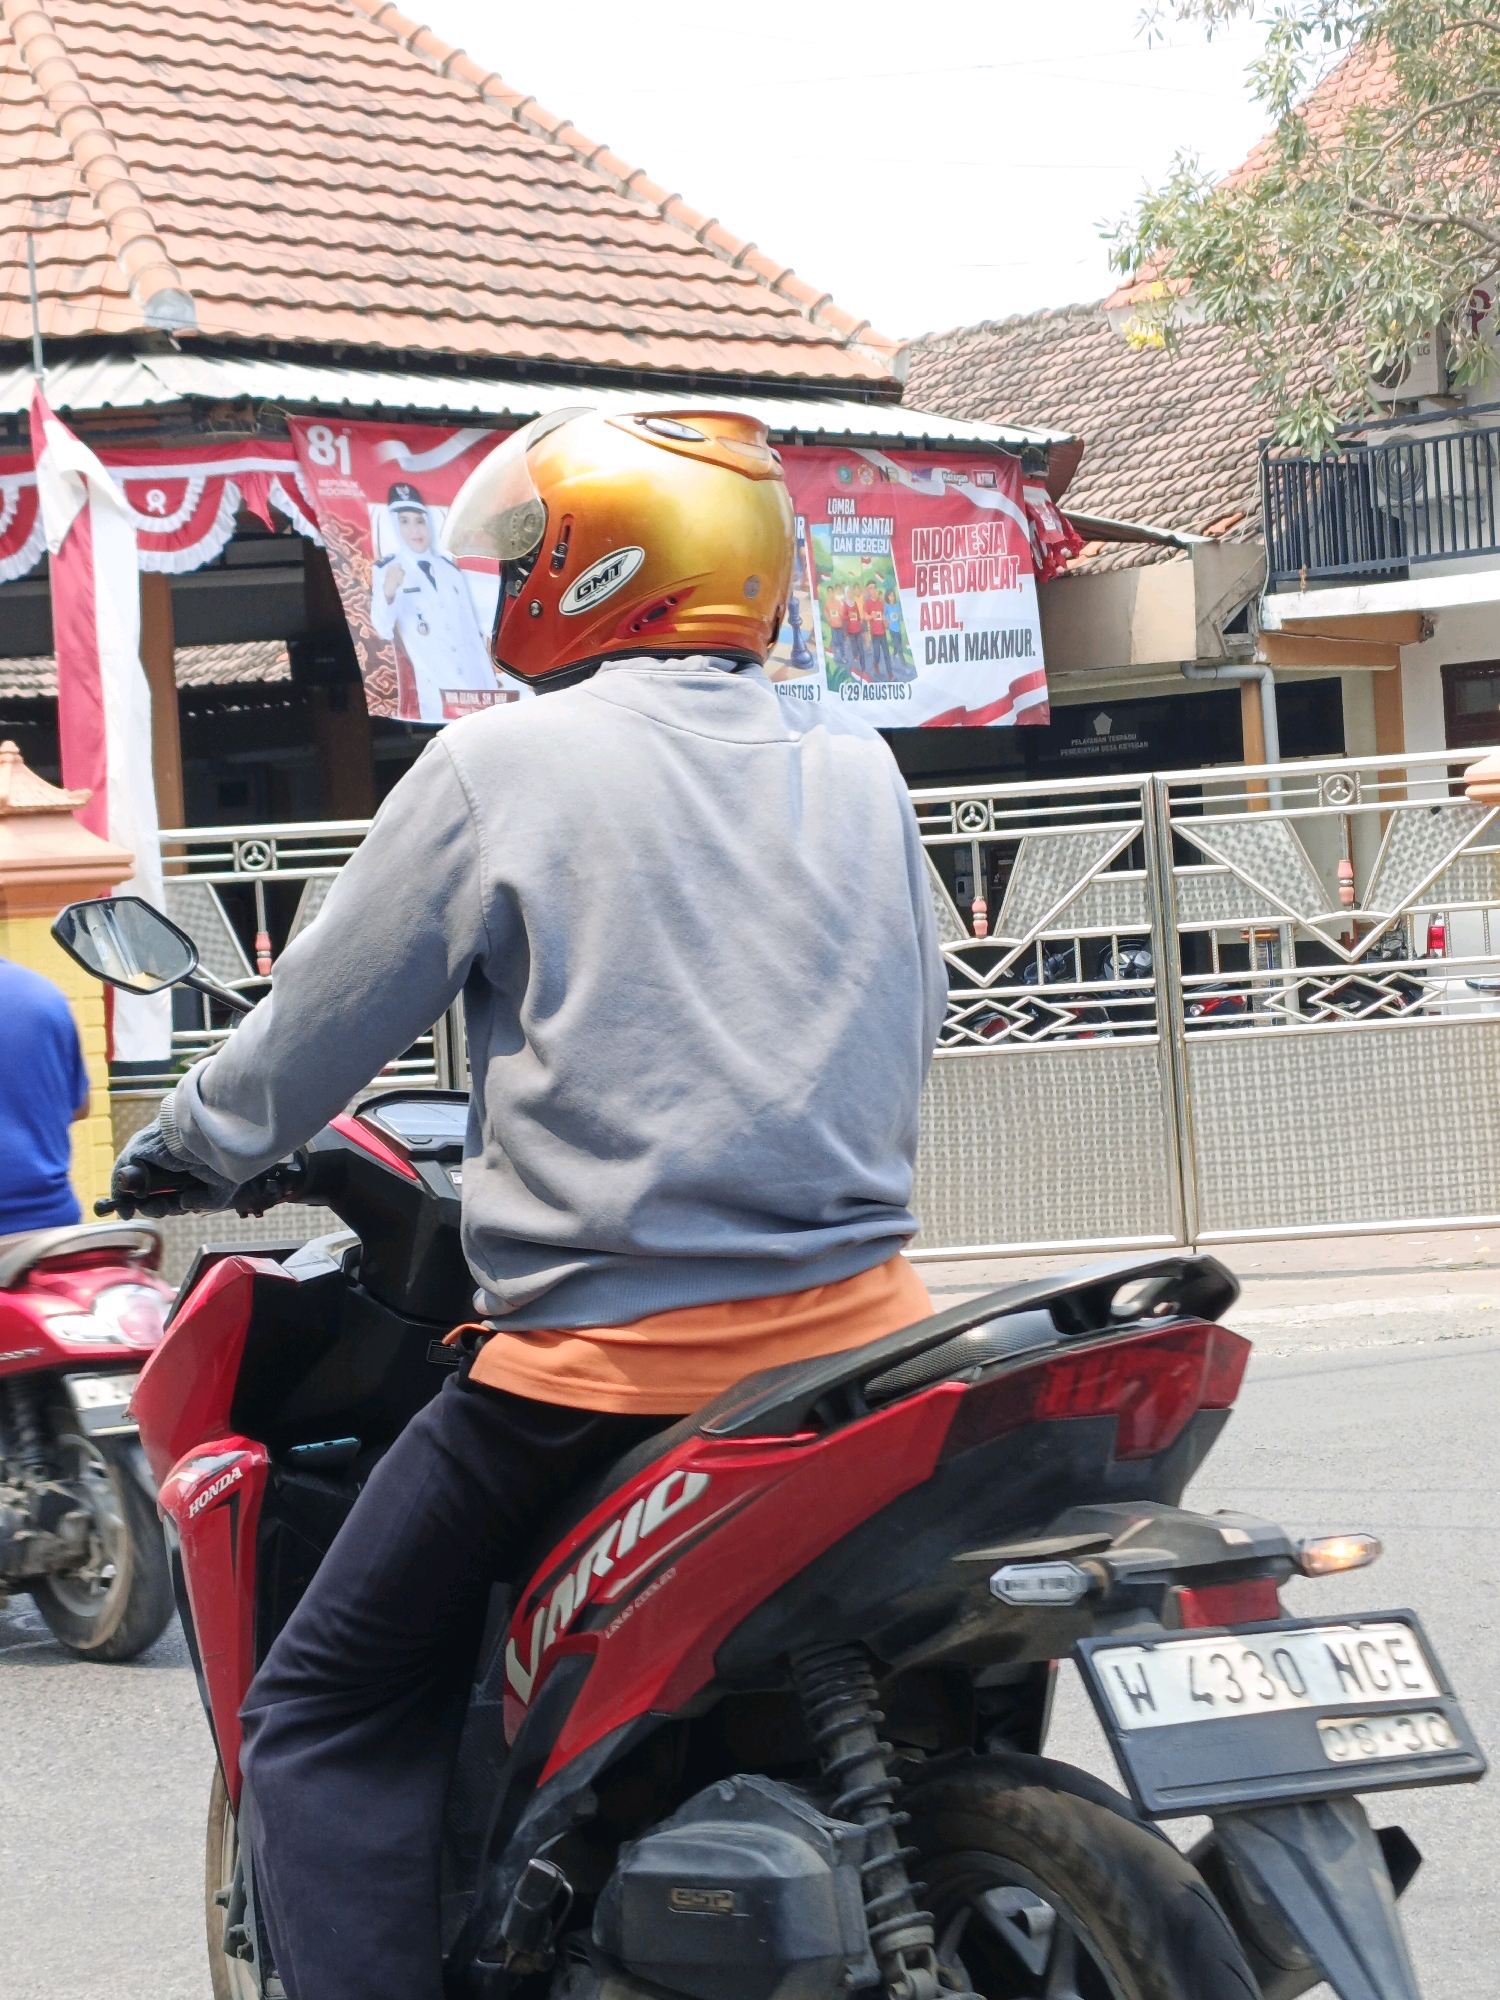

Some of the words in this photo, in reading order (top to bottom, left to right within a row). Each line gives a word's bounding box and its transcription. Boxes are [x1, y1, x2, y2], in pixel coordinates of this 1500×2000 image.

[1417, 346, 1431, 356] LG
[306, 424, 352, 476] 81
[827, 497, 855, 515] LOMBA
[831, 516, 860, 535] JALAN
[861, 516, 894, 536] SANTAI
[833, 537, 853, 553] DAN
[854, 536, 890, 554] BEREGU
[913, 522, 1007, 562] INDONESIA
[575, 555, 628, 602] GMT
[916, 556, 1023, 598] BERDAULAT,
[920, 599, 964, 632] ADIL,
[925, 633, 960, 666] DAN
[964, 628, 1036, 662] MAKMUR.
[862, 684, 906, 701] AGUSTUS
[189, 1466, 243, 1519] HONDA
[505, 1470, 711, 1706] VARIO
[1114, 1662, 1156, 1714] W
[1188, 1647, 1306, 1706] 4330
[1323, 1637, 1422, 1697] NGE
